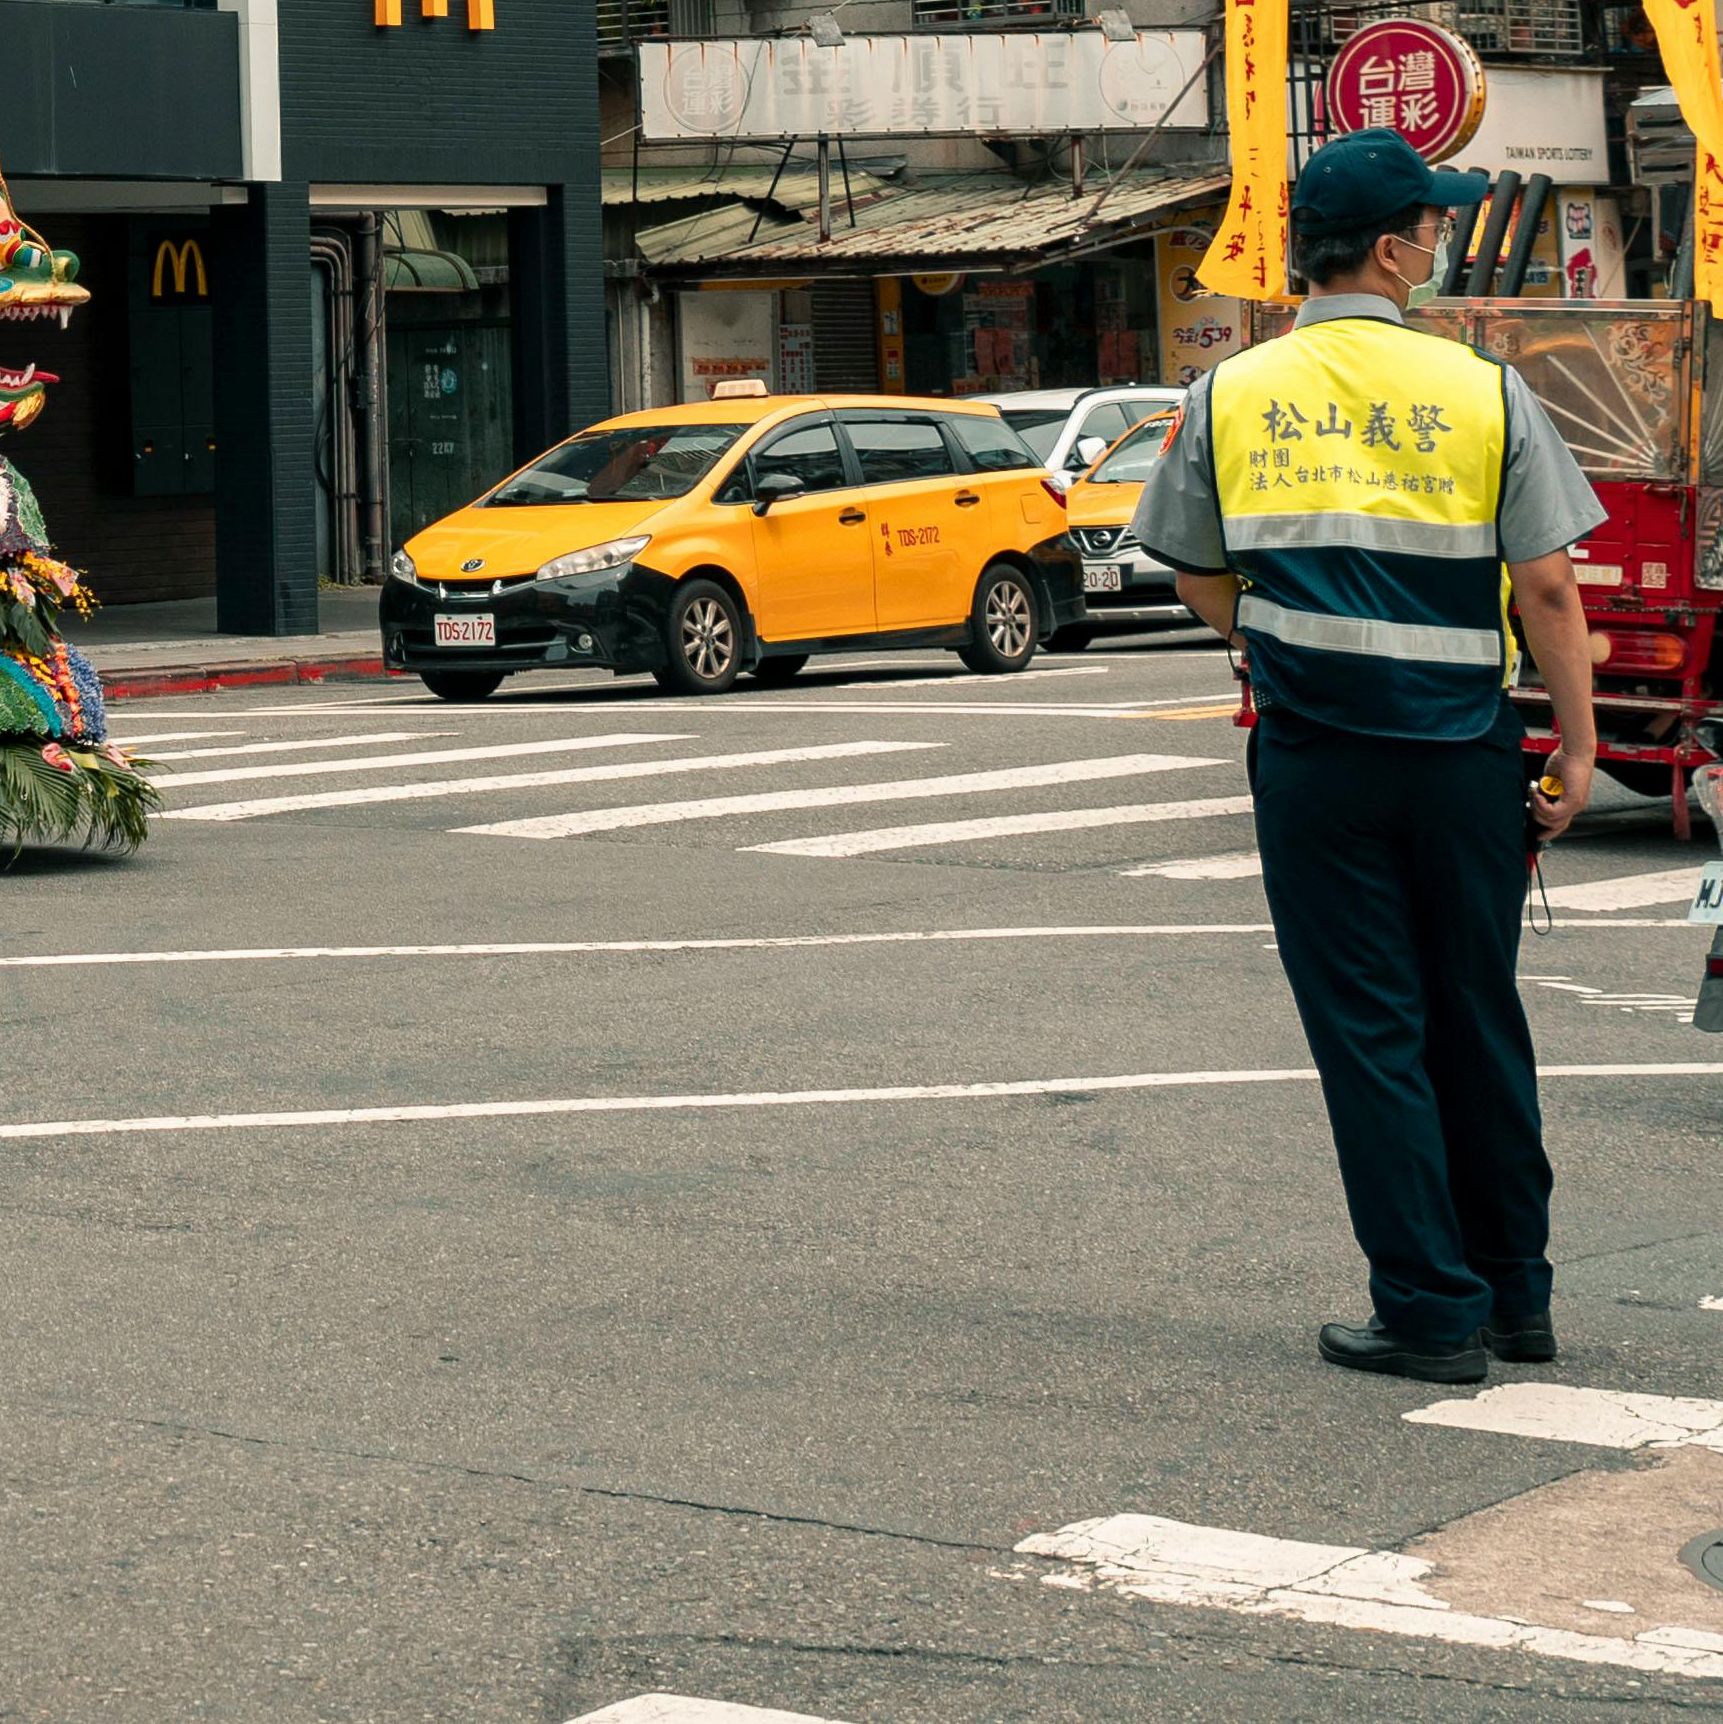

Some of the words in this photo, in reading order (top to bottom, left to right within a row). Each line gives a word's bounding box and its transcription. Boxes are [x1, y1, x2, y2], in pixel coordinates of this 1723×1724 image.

[1359, 50, 1436, 95] 台灣
[1359, 90, 1441, 132] 運彩
[1505, 146, 1536, 159] TAIWAN
[1537, 147, 1564, 160] SPORTS
[1262, 399, 1452, 453] 松山義警
[1250, 471, 1293, 491] 法人
[896, 526, 941, 547] TDS-2172
[436, 621, 494, 641] TDS-2172
